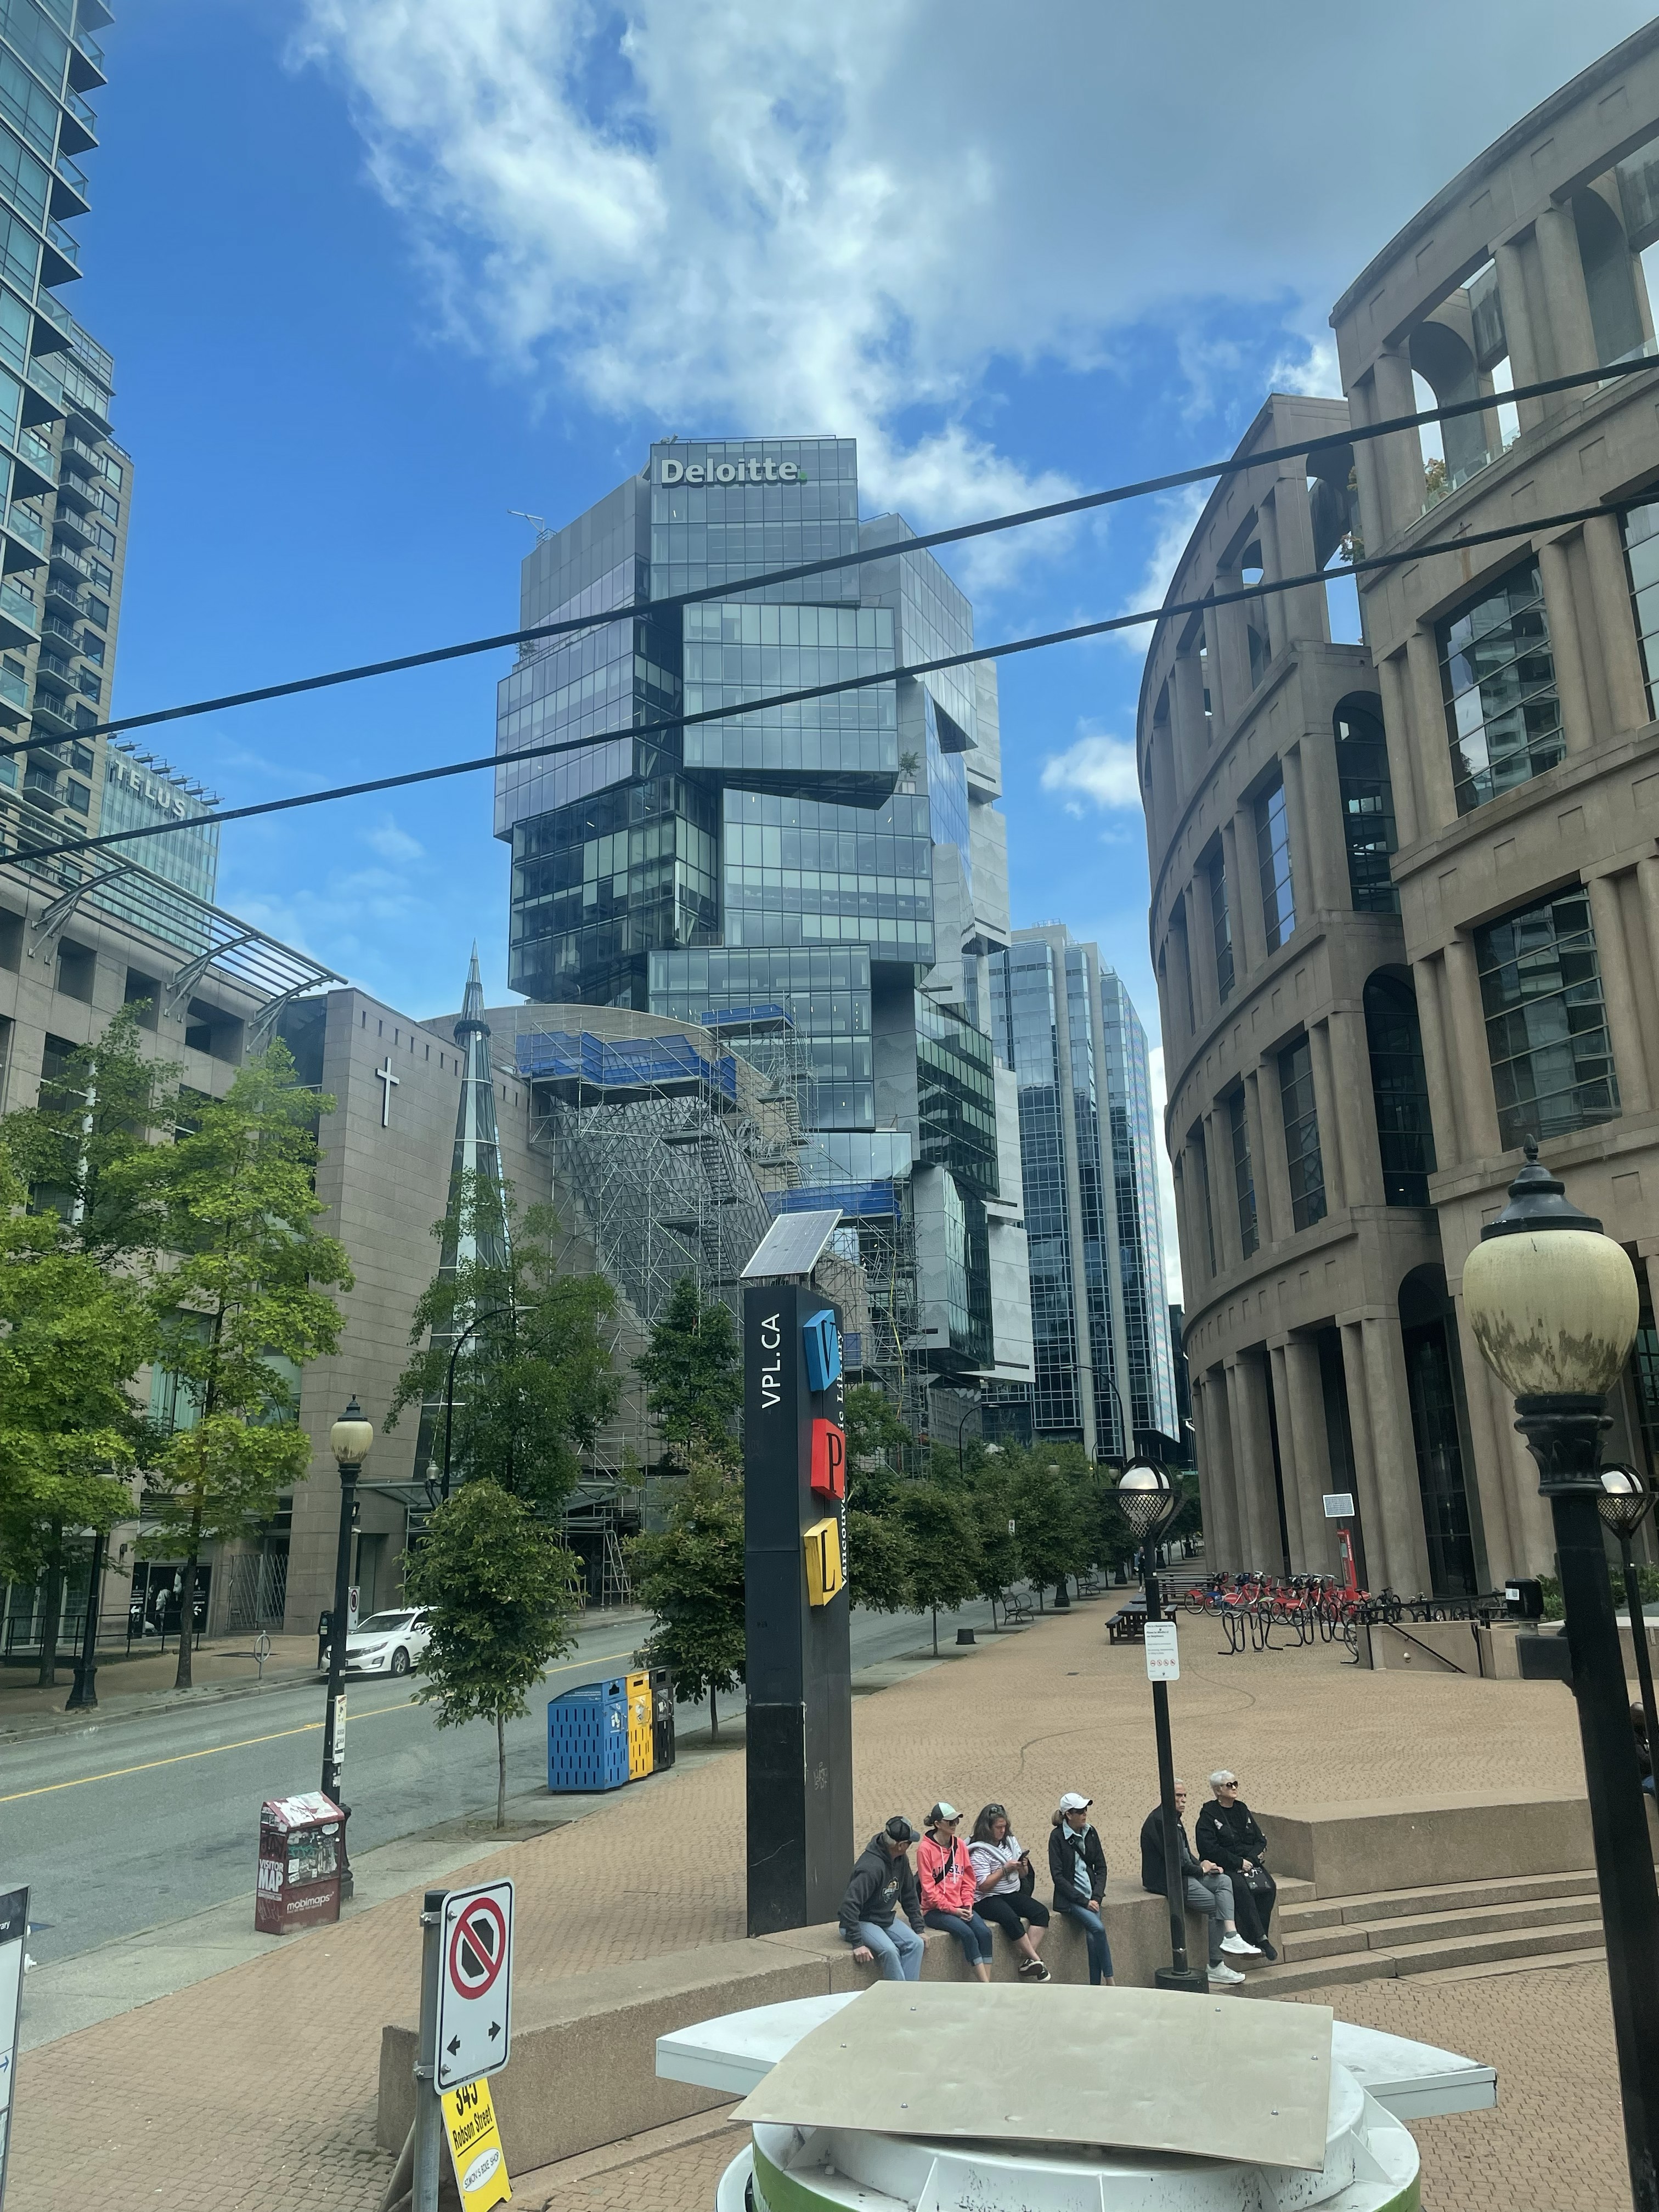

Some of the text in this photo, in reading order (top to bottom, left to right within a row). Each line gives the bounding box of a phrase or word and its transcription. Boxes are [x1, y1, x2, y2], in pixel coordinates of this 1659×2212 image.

[114, 759, 185, 819] TELUS
[761, 1312, 781, 1409] VPL.CA
[259, 1859, 284, 1872] VISITOR
[258, 1869, 284, 1893] MAP
[286, 1893, 330, 1911] mobimaps
[452, 2104, 493, 2151] Robson Street
[489, 2151, 500, 2166] SHOP
